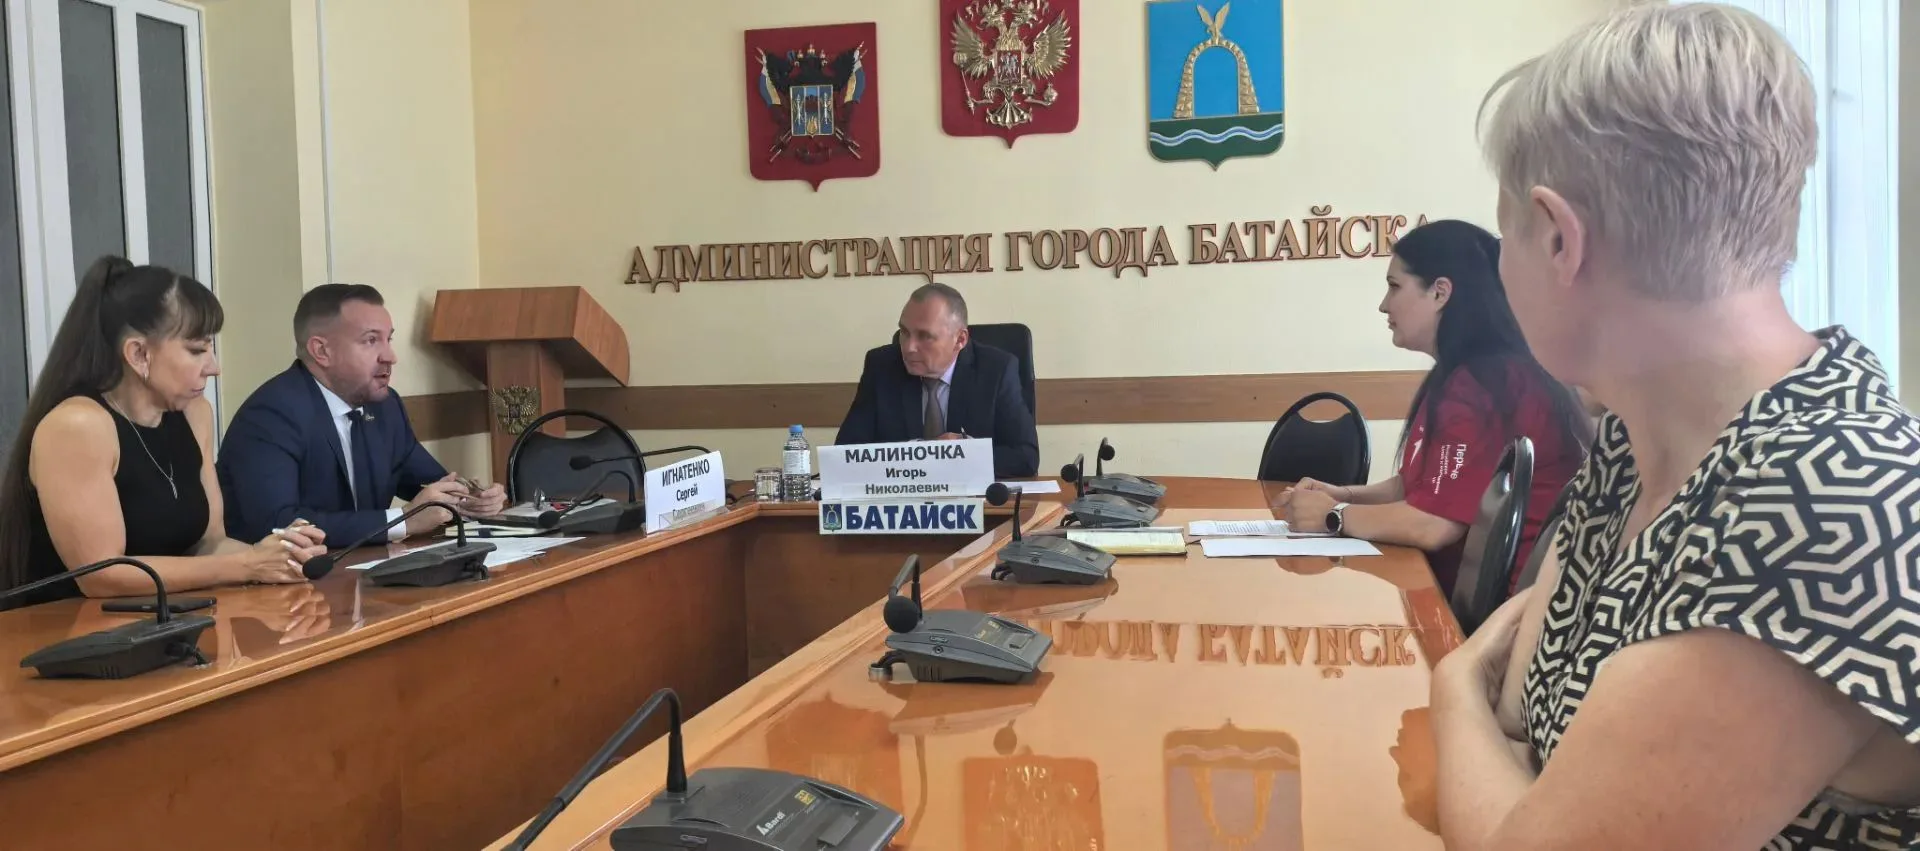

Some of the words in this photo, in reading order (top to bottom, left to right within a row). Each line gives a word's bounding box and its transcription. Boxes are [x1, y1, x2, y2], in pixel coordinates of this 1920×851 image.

[624, 232, 994, 293] АДМИНИСТРАЦИЯ
[1004, 225, 1179, 278] ГОРОДА
[1187, 204, 1429, 266] БАТАЙСК
[845, 444, 966, 464] МАЛИНОЧКА
[662, 458, 710, 487] ИГНАТЕНКО
[885, 468, 927, 480] Игорь
[676, 484, 698, 502] Сергей
[865, 483, 949, 495] Николаевич
[845, 501, 978, 530] БАТАЙСК
